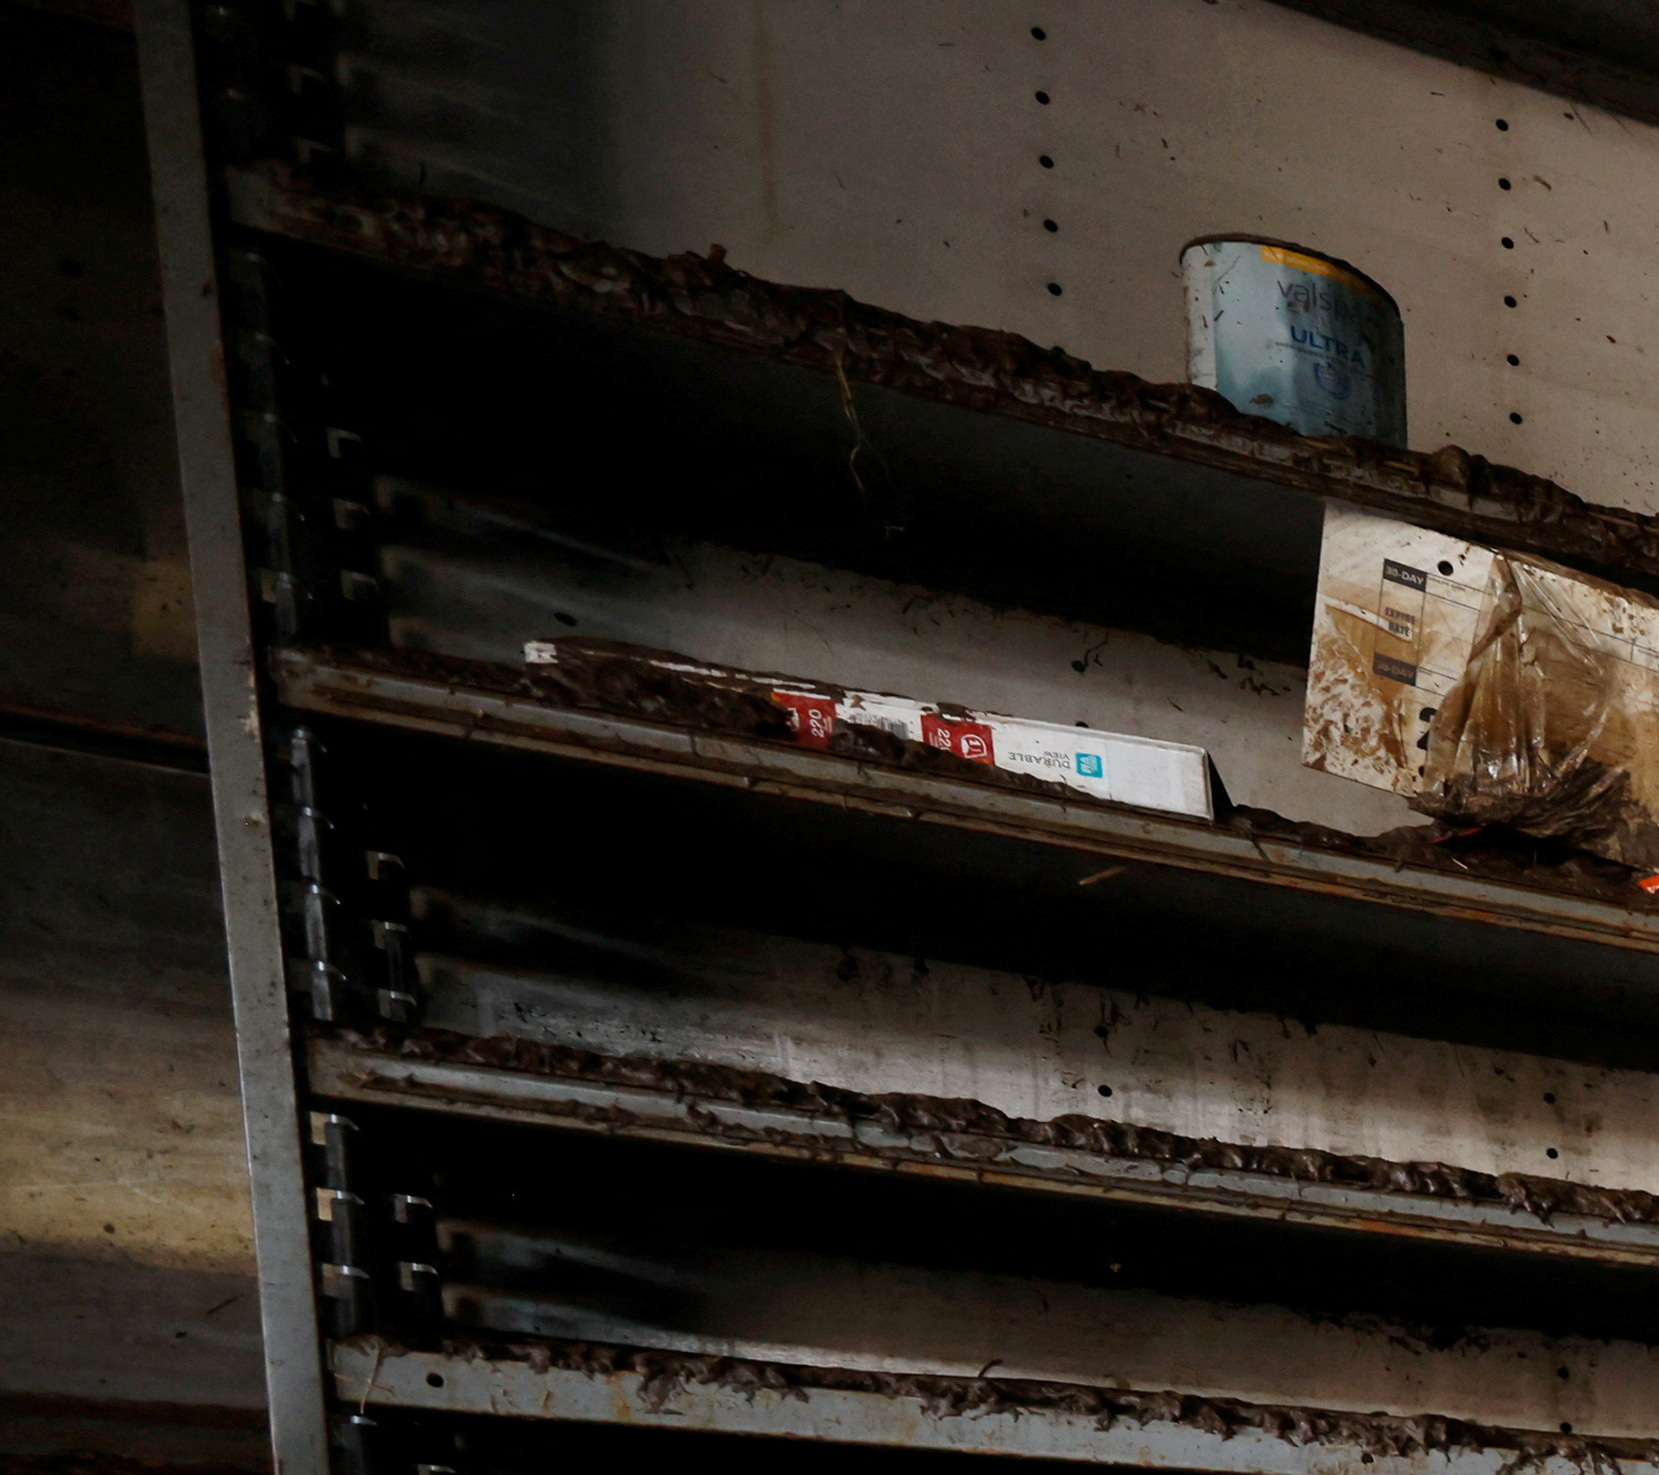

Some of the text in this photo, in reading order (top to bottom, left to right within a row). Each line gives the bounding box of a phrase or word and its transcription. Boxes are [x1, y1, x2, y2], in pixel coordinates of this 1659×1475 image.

[1290, 325, 1366, 368] ULTRA
[1385, 565, 1425, 586] 30-DAY
[808, 708, 826, 739] 220
[1008, 751, 1071, 770] DURABLE
[1043, 750, 1069, 761] VIEW
